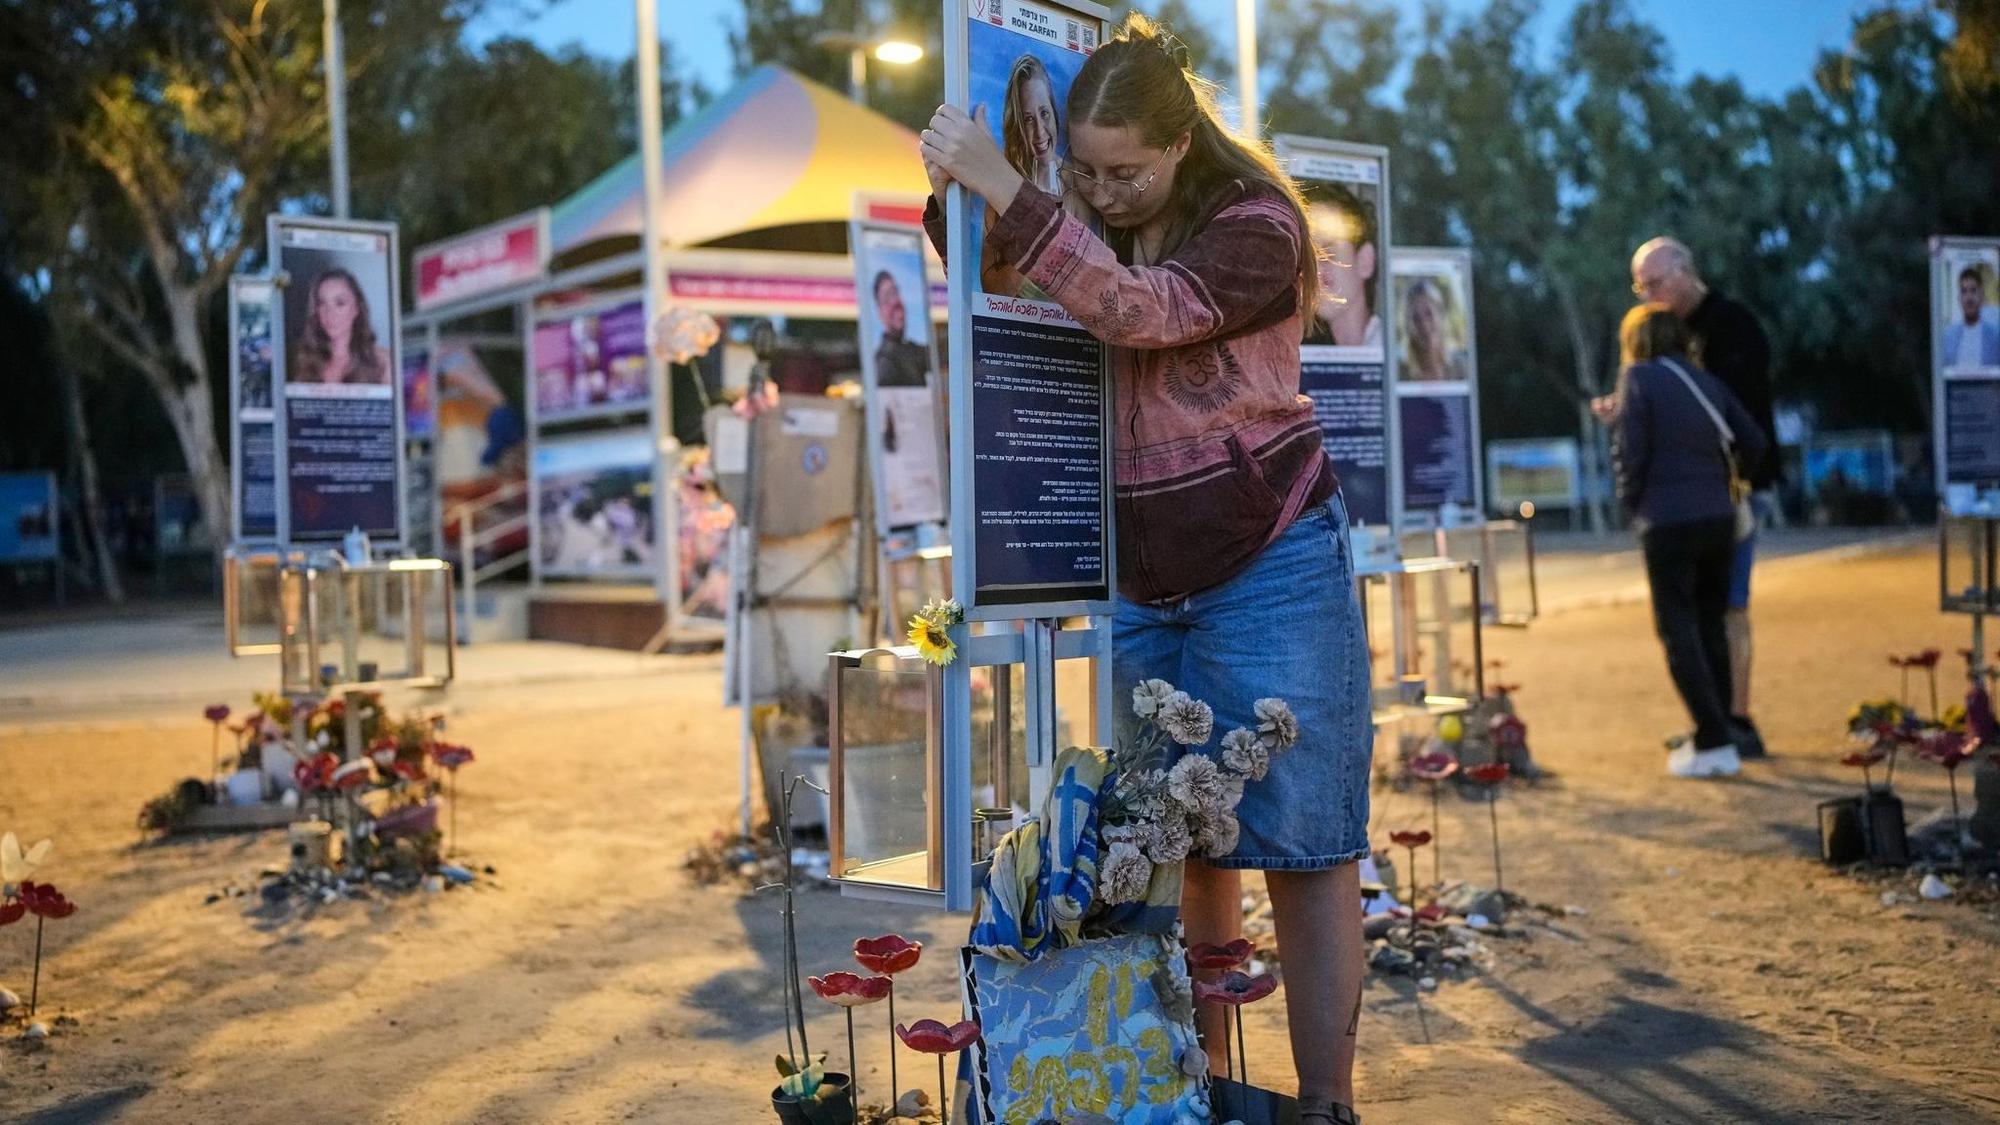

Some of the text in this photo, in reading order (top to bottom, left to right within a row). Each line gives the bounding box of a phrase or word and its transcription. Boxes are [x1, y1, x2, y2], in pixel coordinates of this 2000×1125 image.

[1019, 8, 1048, 24] רון צרפתי
[1011, 17, 1027, 29] RON
[1028, 23, 1057, 39] ZARFATI
[1088, 960, 1158, 1046] ון
